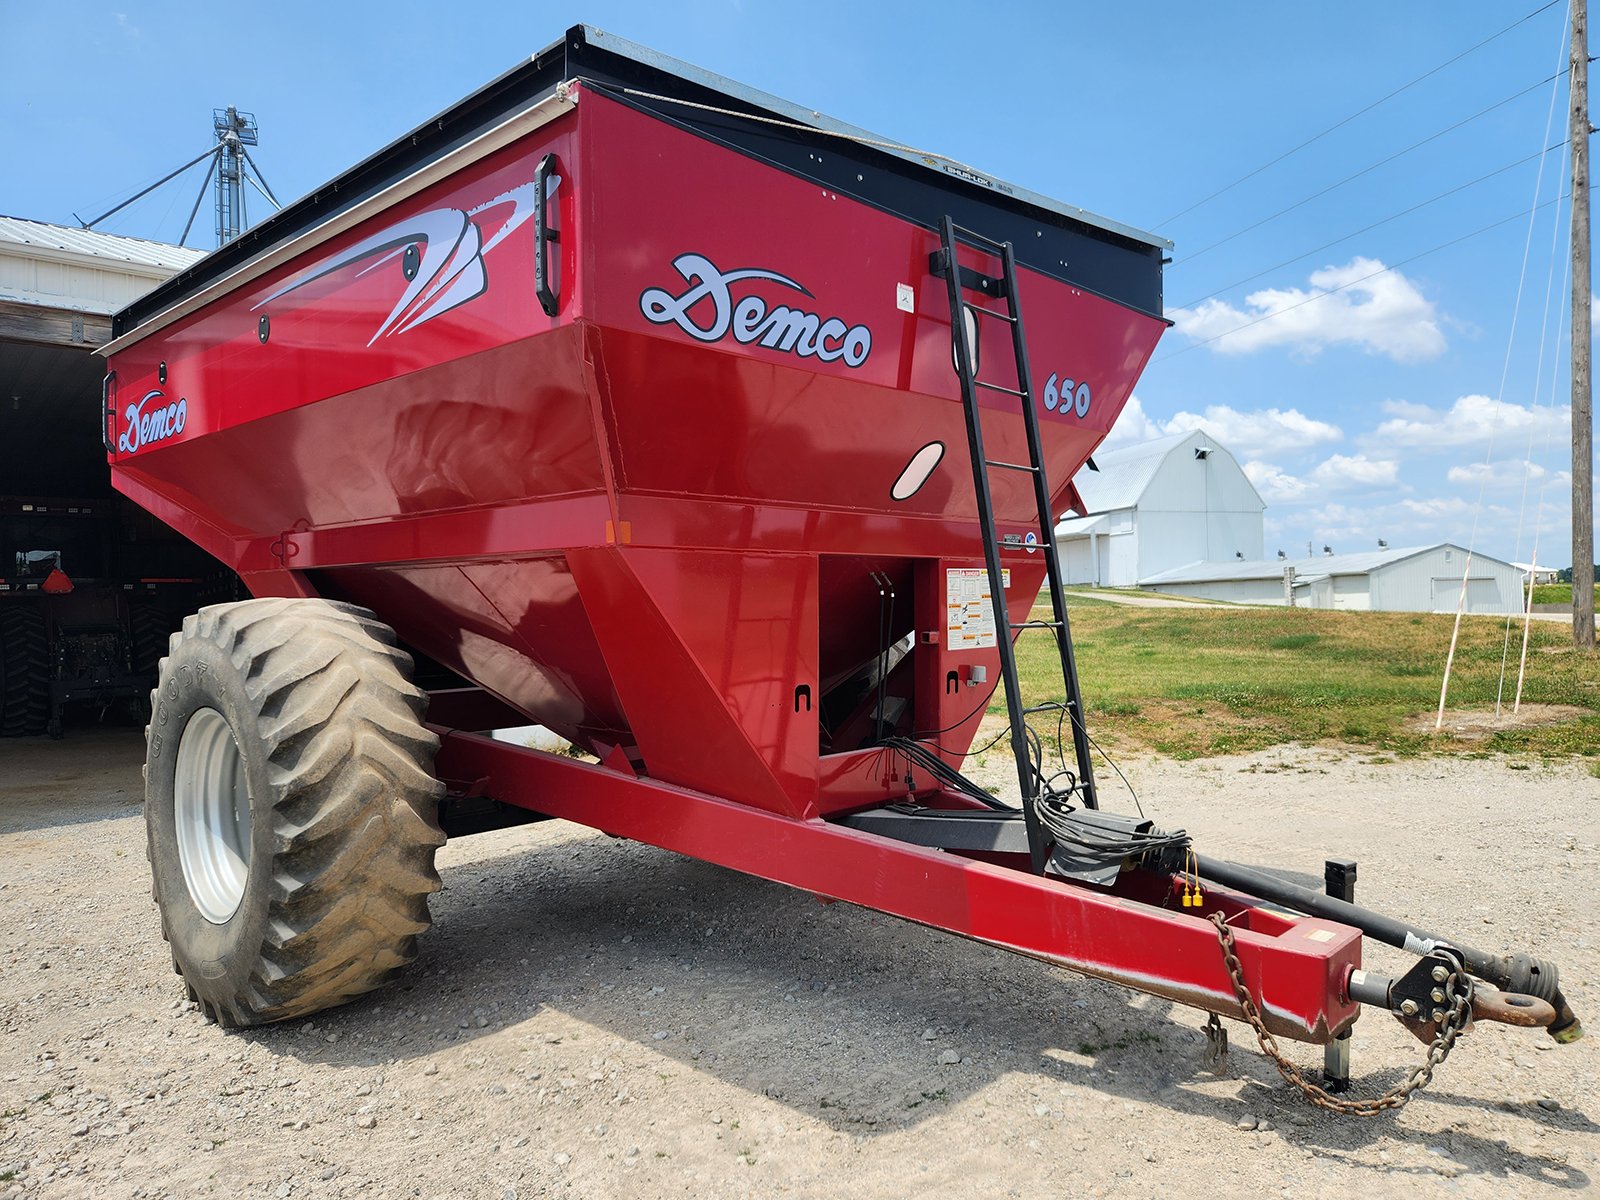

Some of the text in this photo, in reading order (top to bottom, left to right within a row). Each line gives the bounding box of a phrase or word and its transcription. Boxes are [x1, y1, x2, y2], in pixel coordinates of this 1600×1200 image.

[947, 166, 989, 186] SHUR-LOK
[640, 252, 872, 367] Demco
[118, 390, 188, 453] Demco
[1043, 371, 1091, 419] 650
